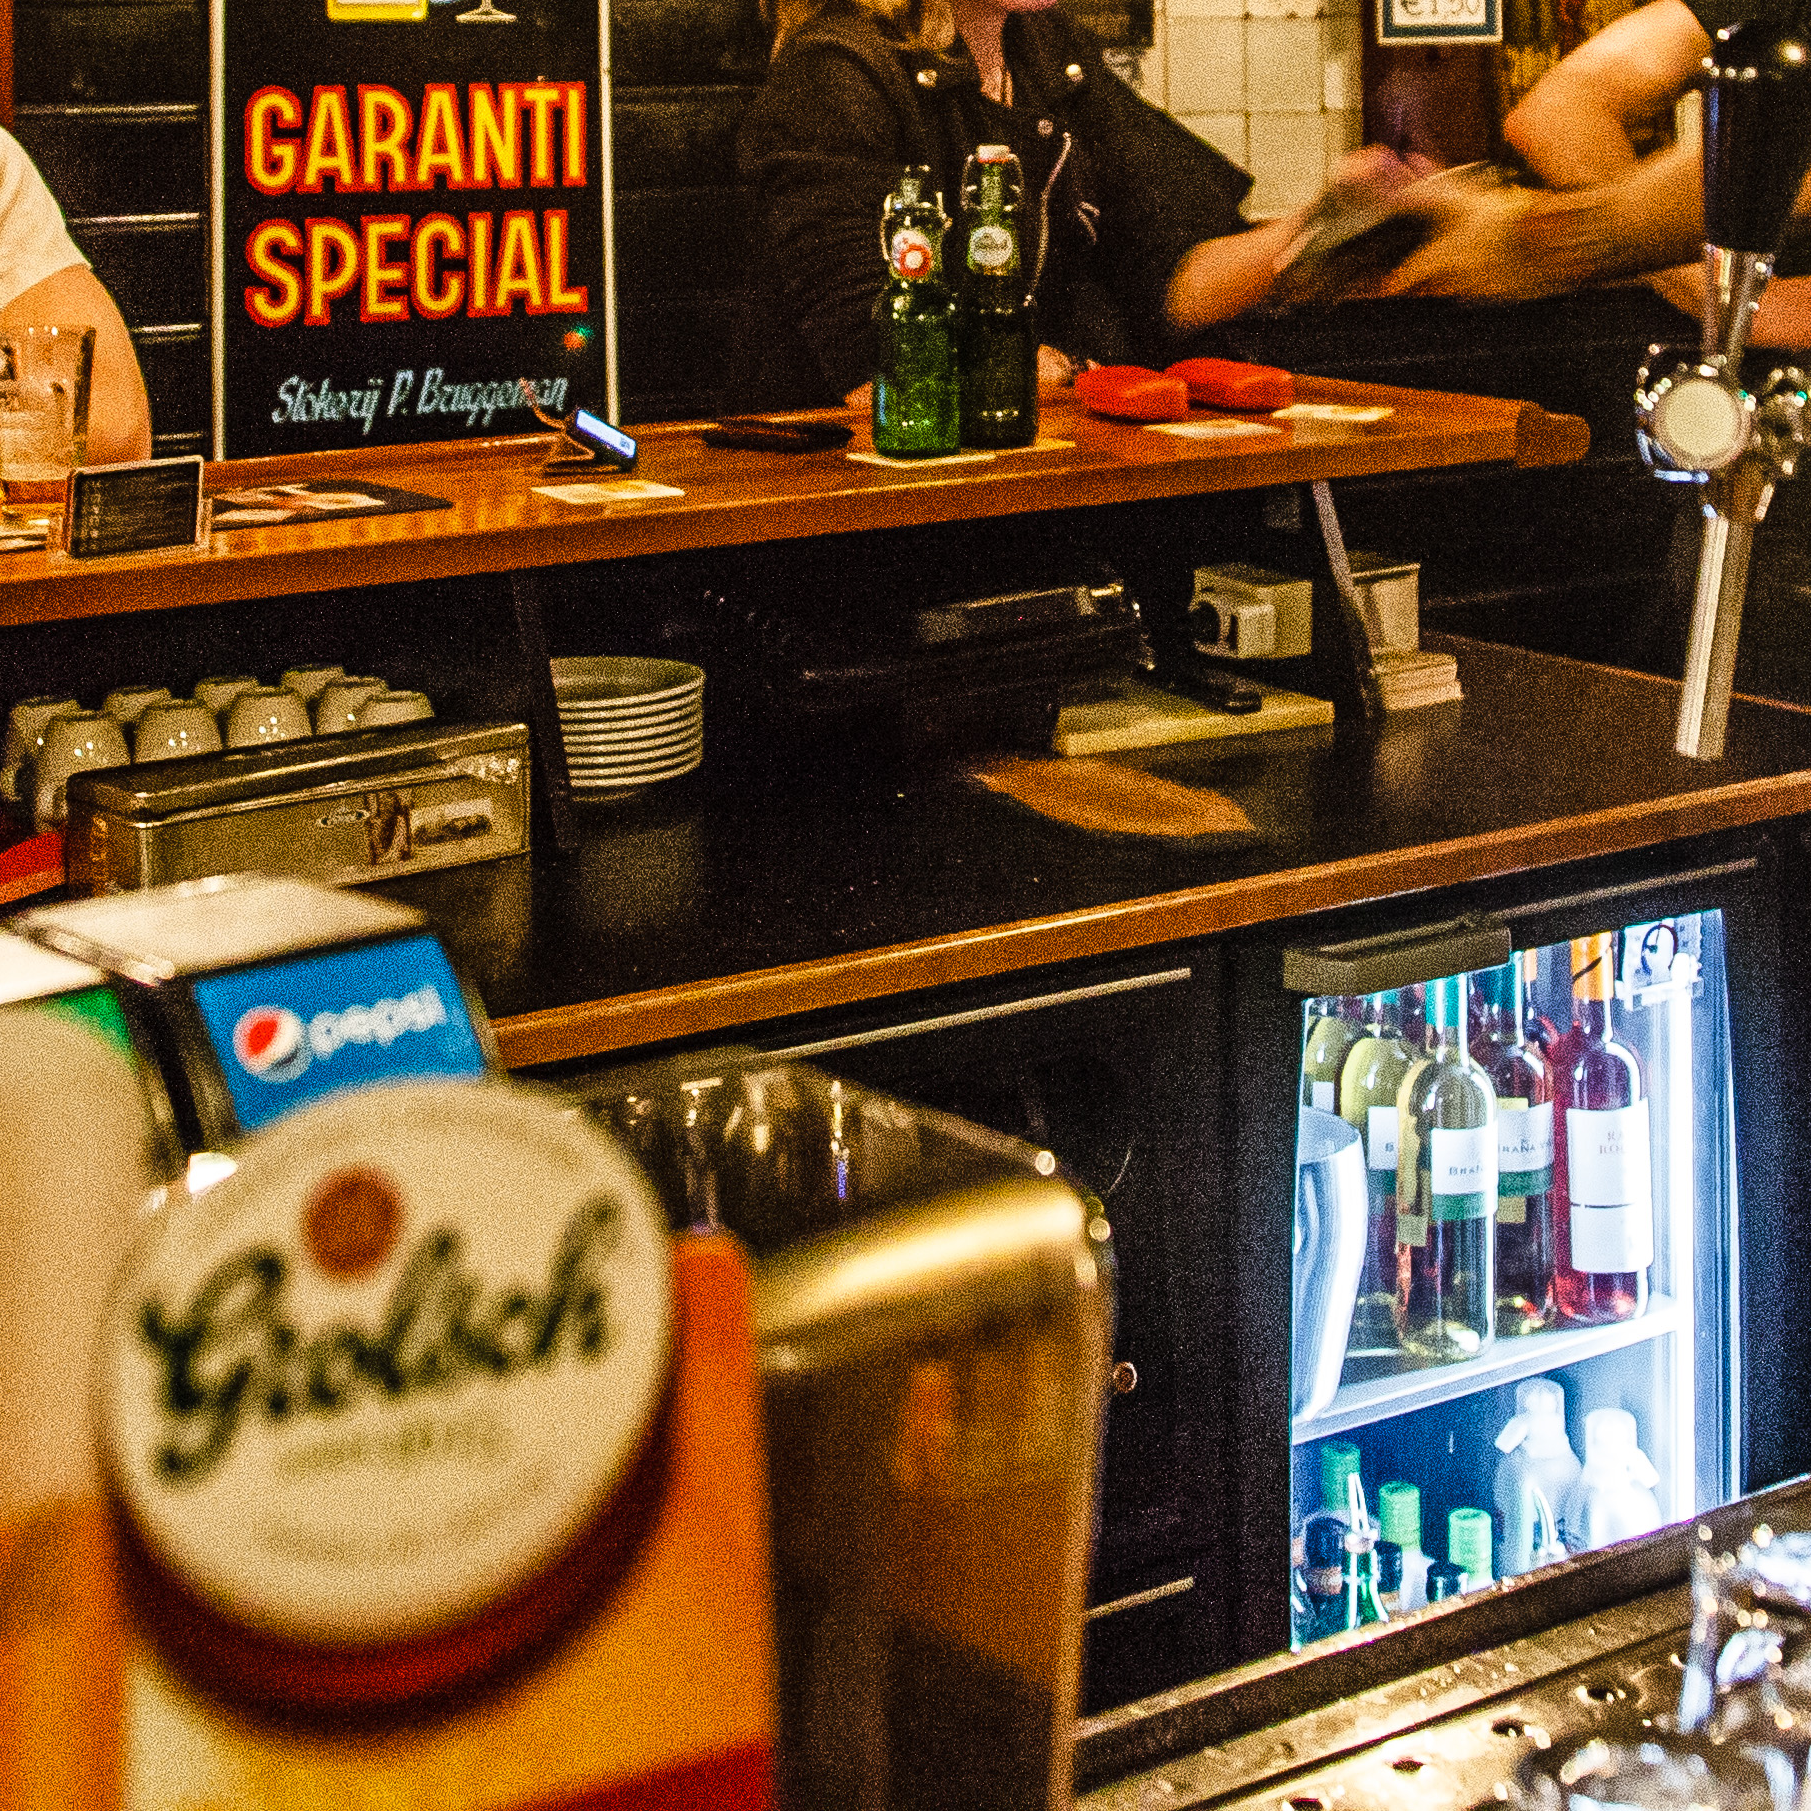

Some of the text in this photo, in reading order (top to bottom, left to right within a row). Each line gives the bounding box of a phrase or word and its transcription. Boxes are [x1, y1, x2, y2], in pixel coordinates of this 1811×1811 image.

[242, 78, 588, 199] GARANTI
[242, 205, 590, 330] SPECIAL
[309, 981, 447, 1065] pepsi
[132, 1192, 625, 1487] Grolsch
